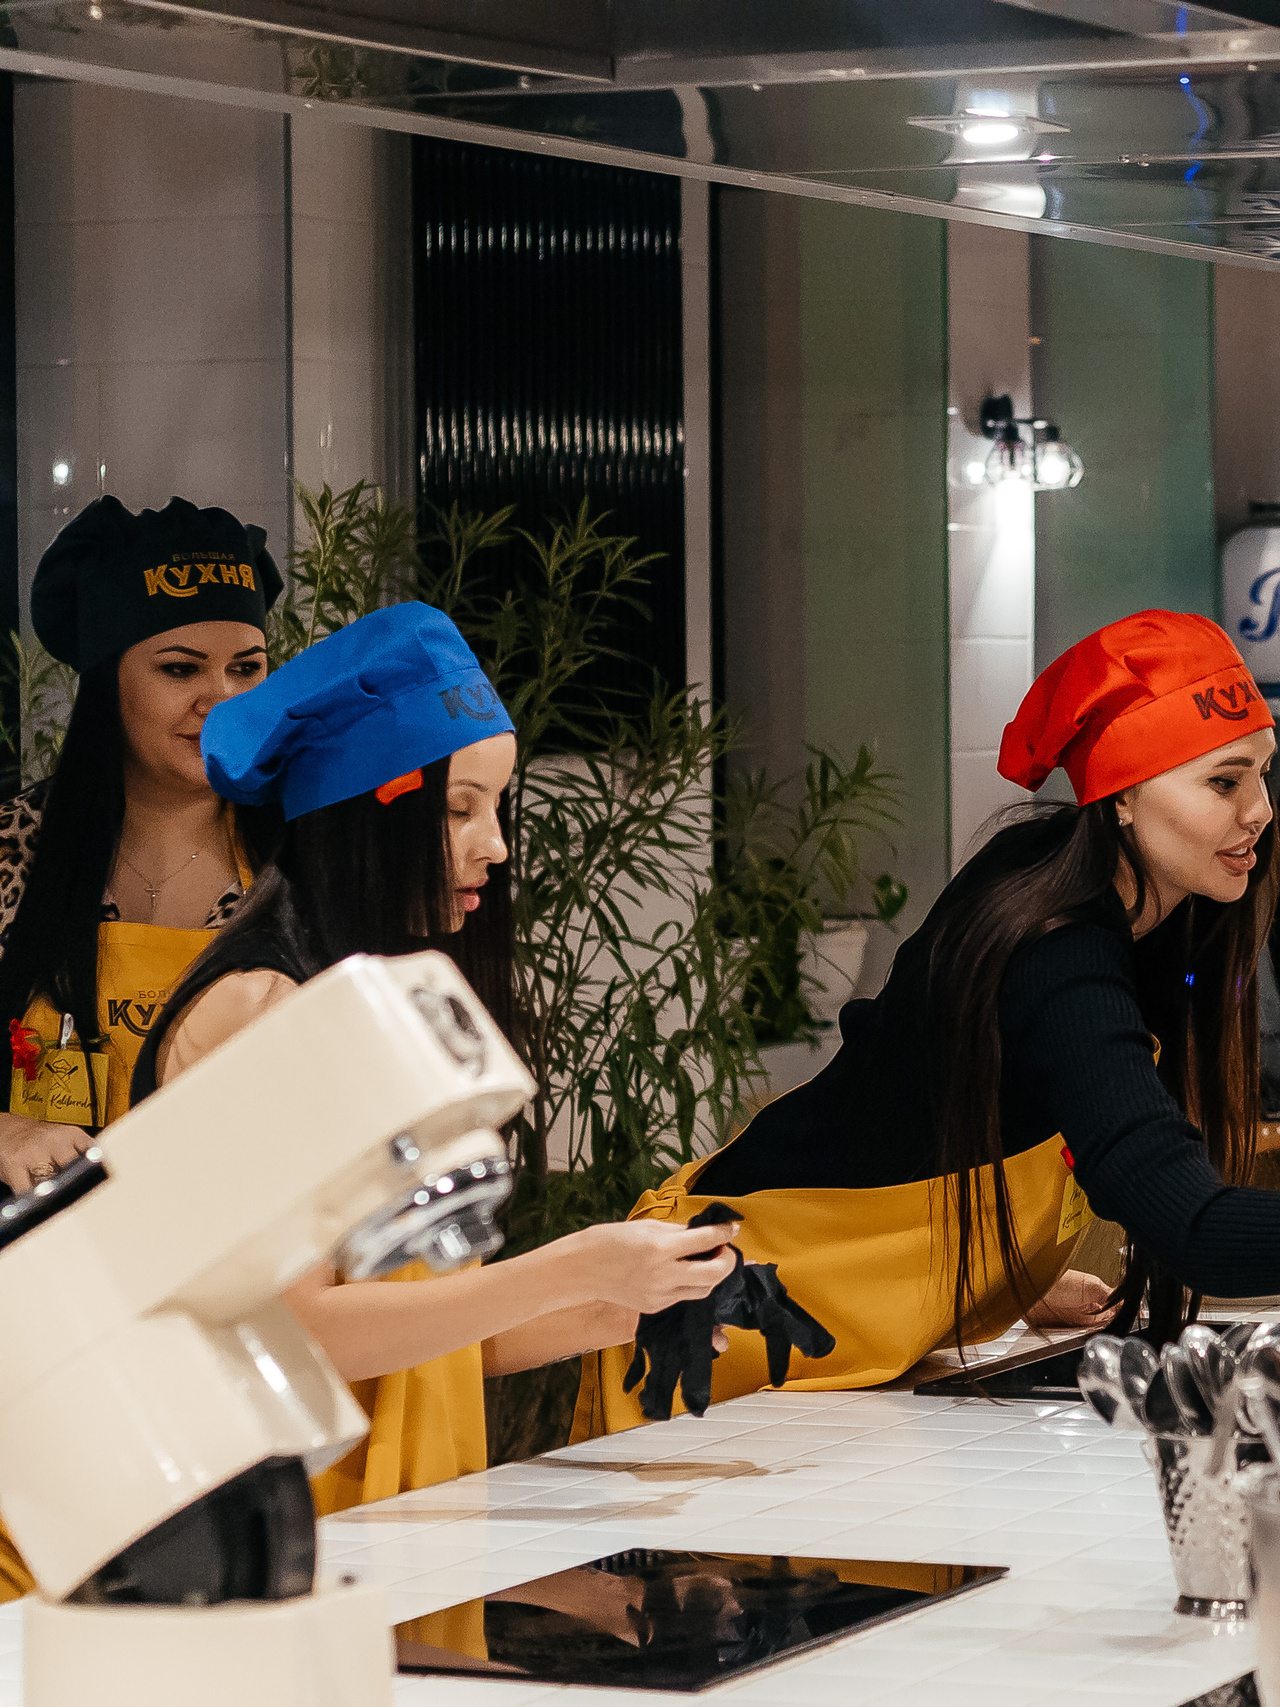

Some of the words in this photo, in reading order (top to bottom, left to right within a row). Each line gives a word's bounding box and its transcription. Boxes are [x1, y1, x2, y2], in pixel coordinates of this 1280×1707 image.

[143, 563, 256, 597] КУХНЯ
[1192, 680, 1262, 721] КУХ
[138, 990, 172, 999] БОЛ
[107, 999, 166, 1038] КУ
